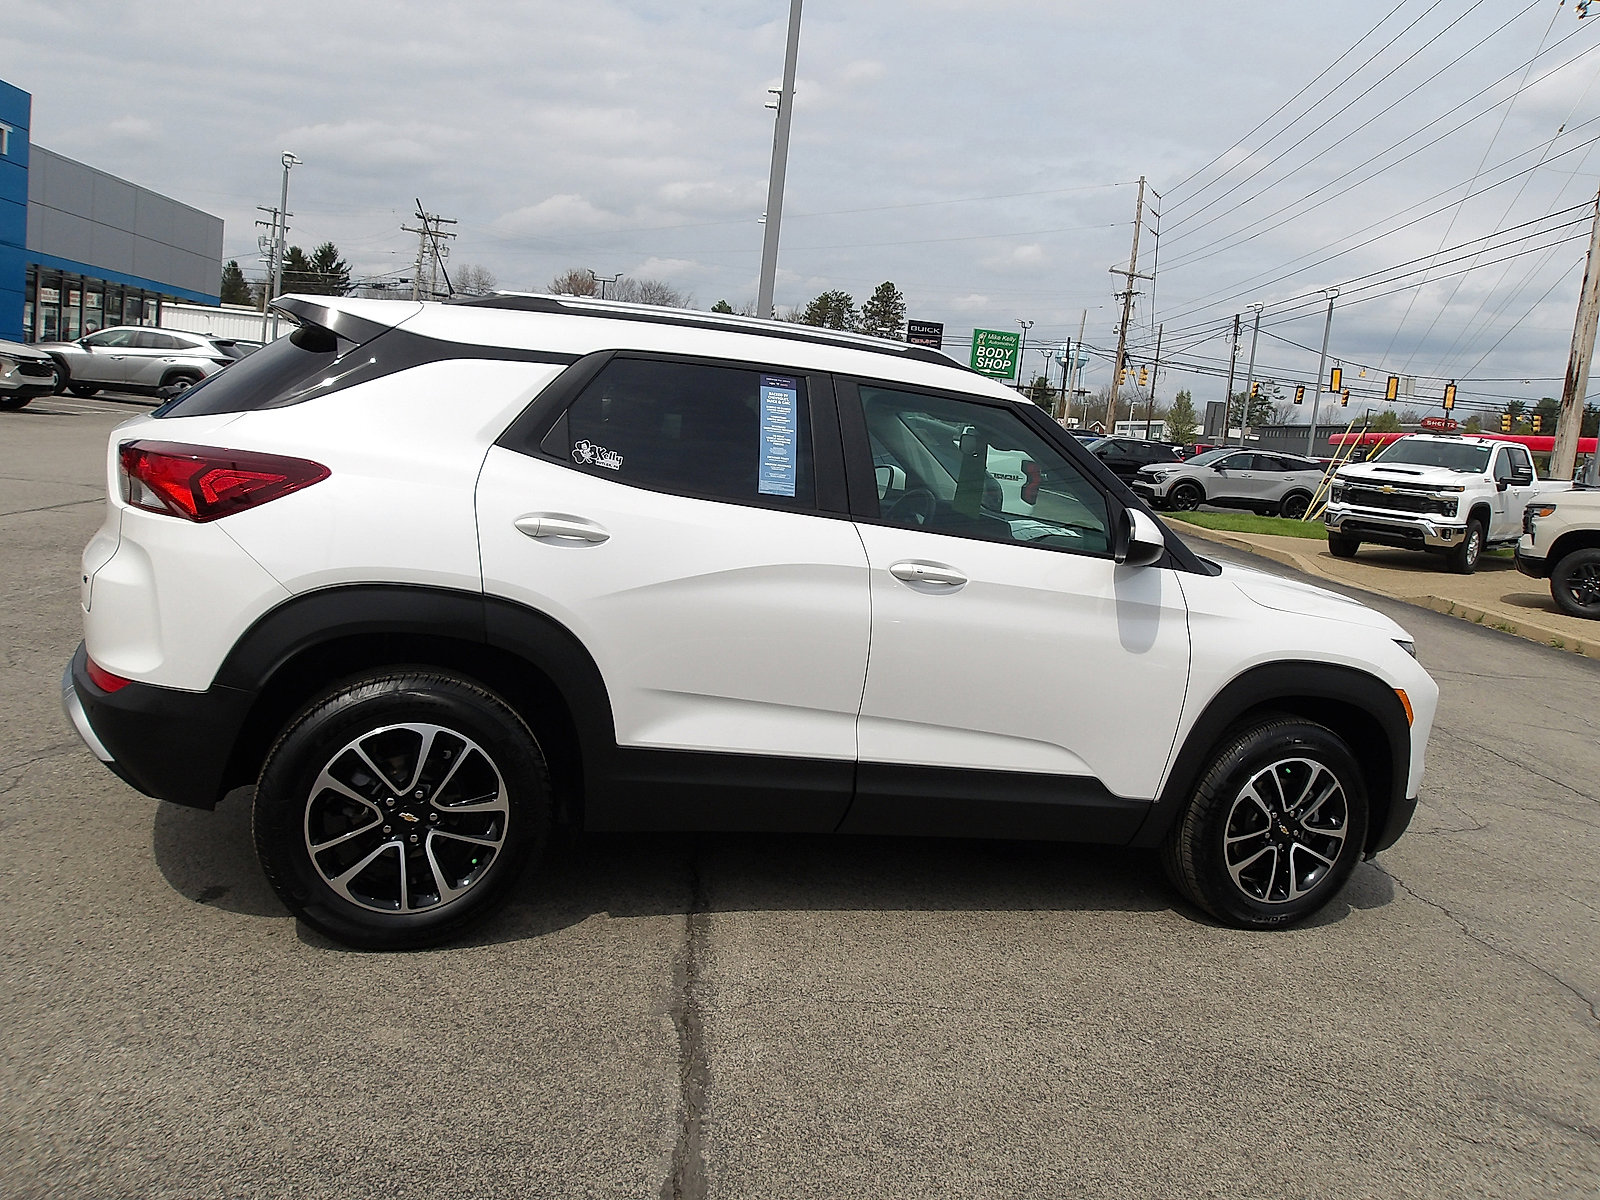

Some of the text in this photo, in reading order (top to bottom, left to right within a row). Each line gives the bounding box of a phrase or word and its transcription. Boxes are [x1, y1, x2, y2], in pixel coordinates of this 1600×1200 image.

[910, 325, 940, 334] BUICK
[911, 337, 938, 346] GMC
[988, 333, 1017, 343] Mike Kelly
[976, 345, 1014, 359] BODY
[976, 356, 1012, 370] SHOP
[597, 447, 624, 465] Kelly
